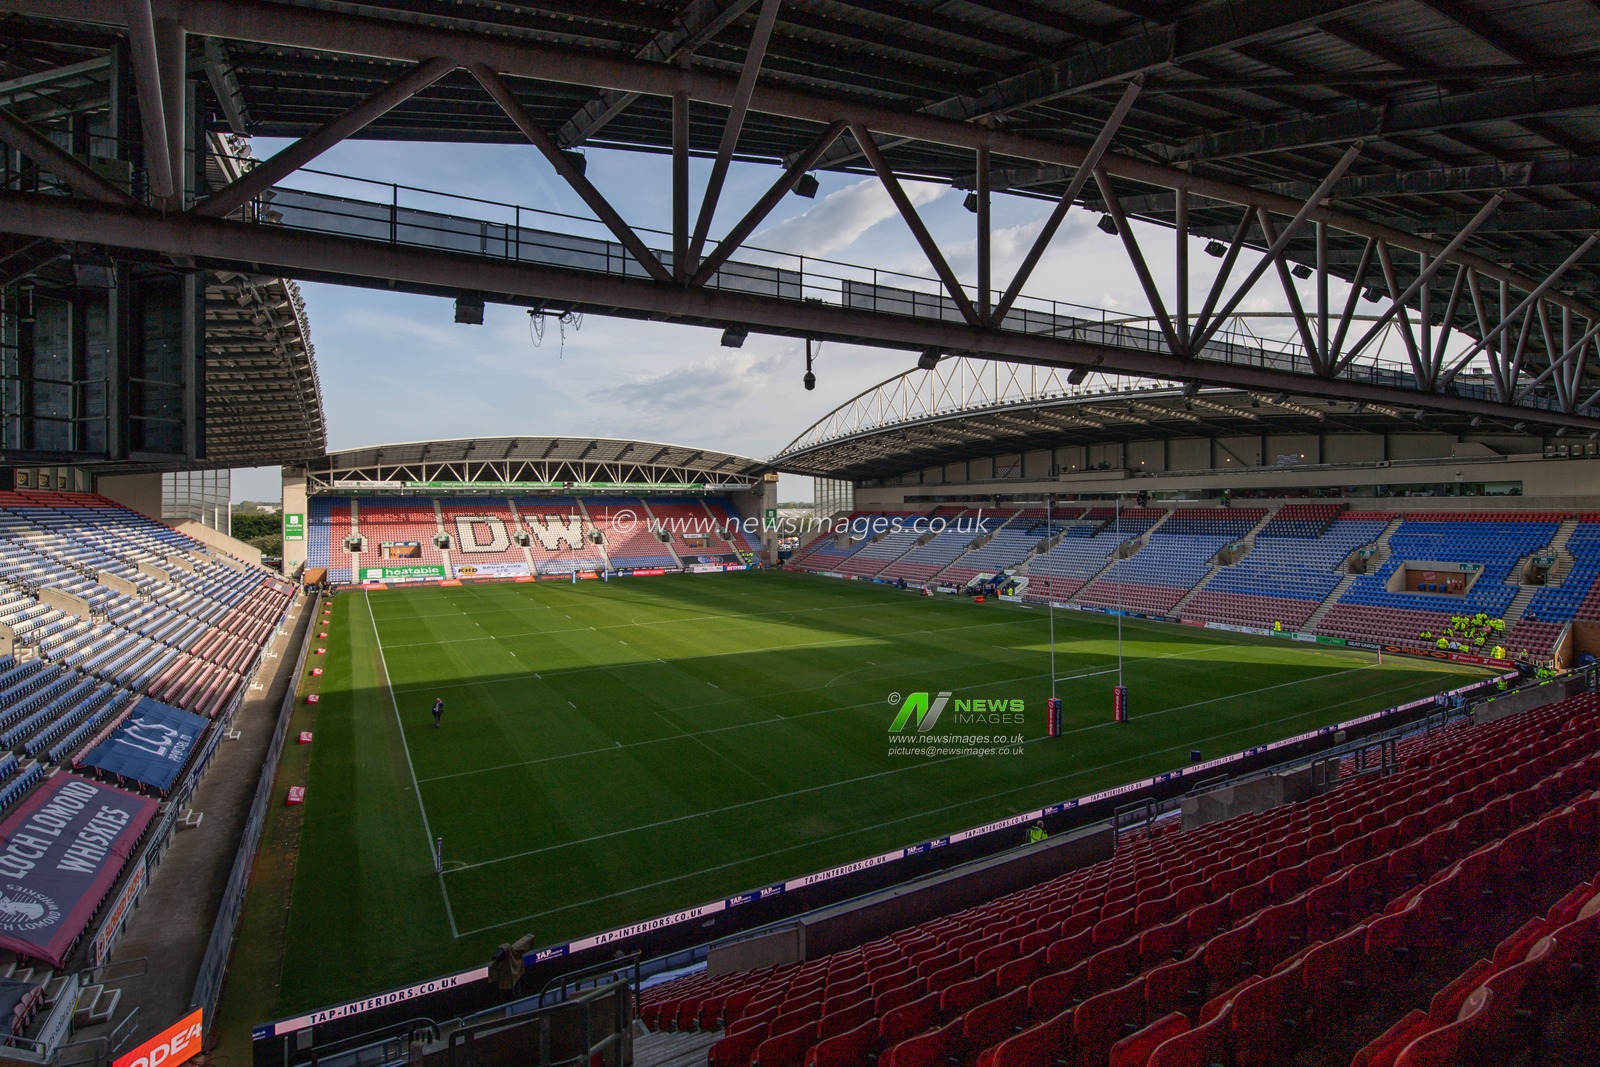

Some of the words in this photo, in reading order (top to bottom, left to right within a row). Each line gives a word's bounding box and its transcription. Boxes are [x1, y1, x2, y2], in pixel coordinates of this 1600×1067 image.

[385, 566, 440, 576] heatable
[115, 717, 178, 757] LCS
[24, 781, 99, 837] LOMOND
[0, 832, 53, 880] LOCH
[56, 805, 130, 874] WHISKIES
[804, 856, 887, 885] TAP-INTERIORS.CO.UK
[595, 908, 703, 945] TAP-INTERIORS.CO.UK
[536, 949, 551, 960] TAP
[310, 976, 458, 1024] TAP-INTERIORS.CO.UK
